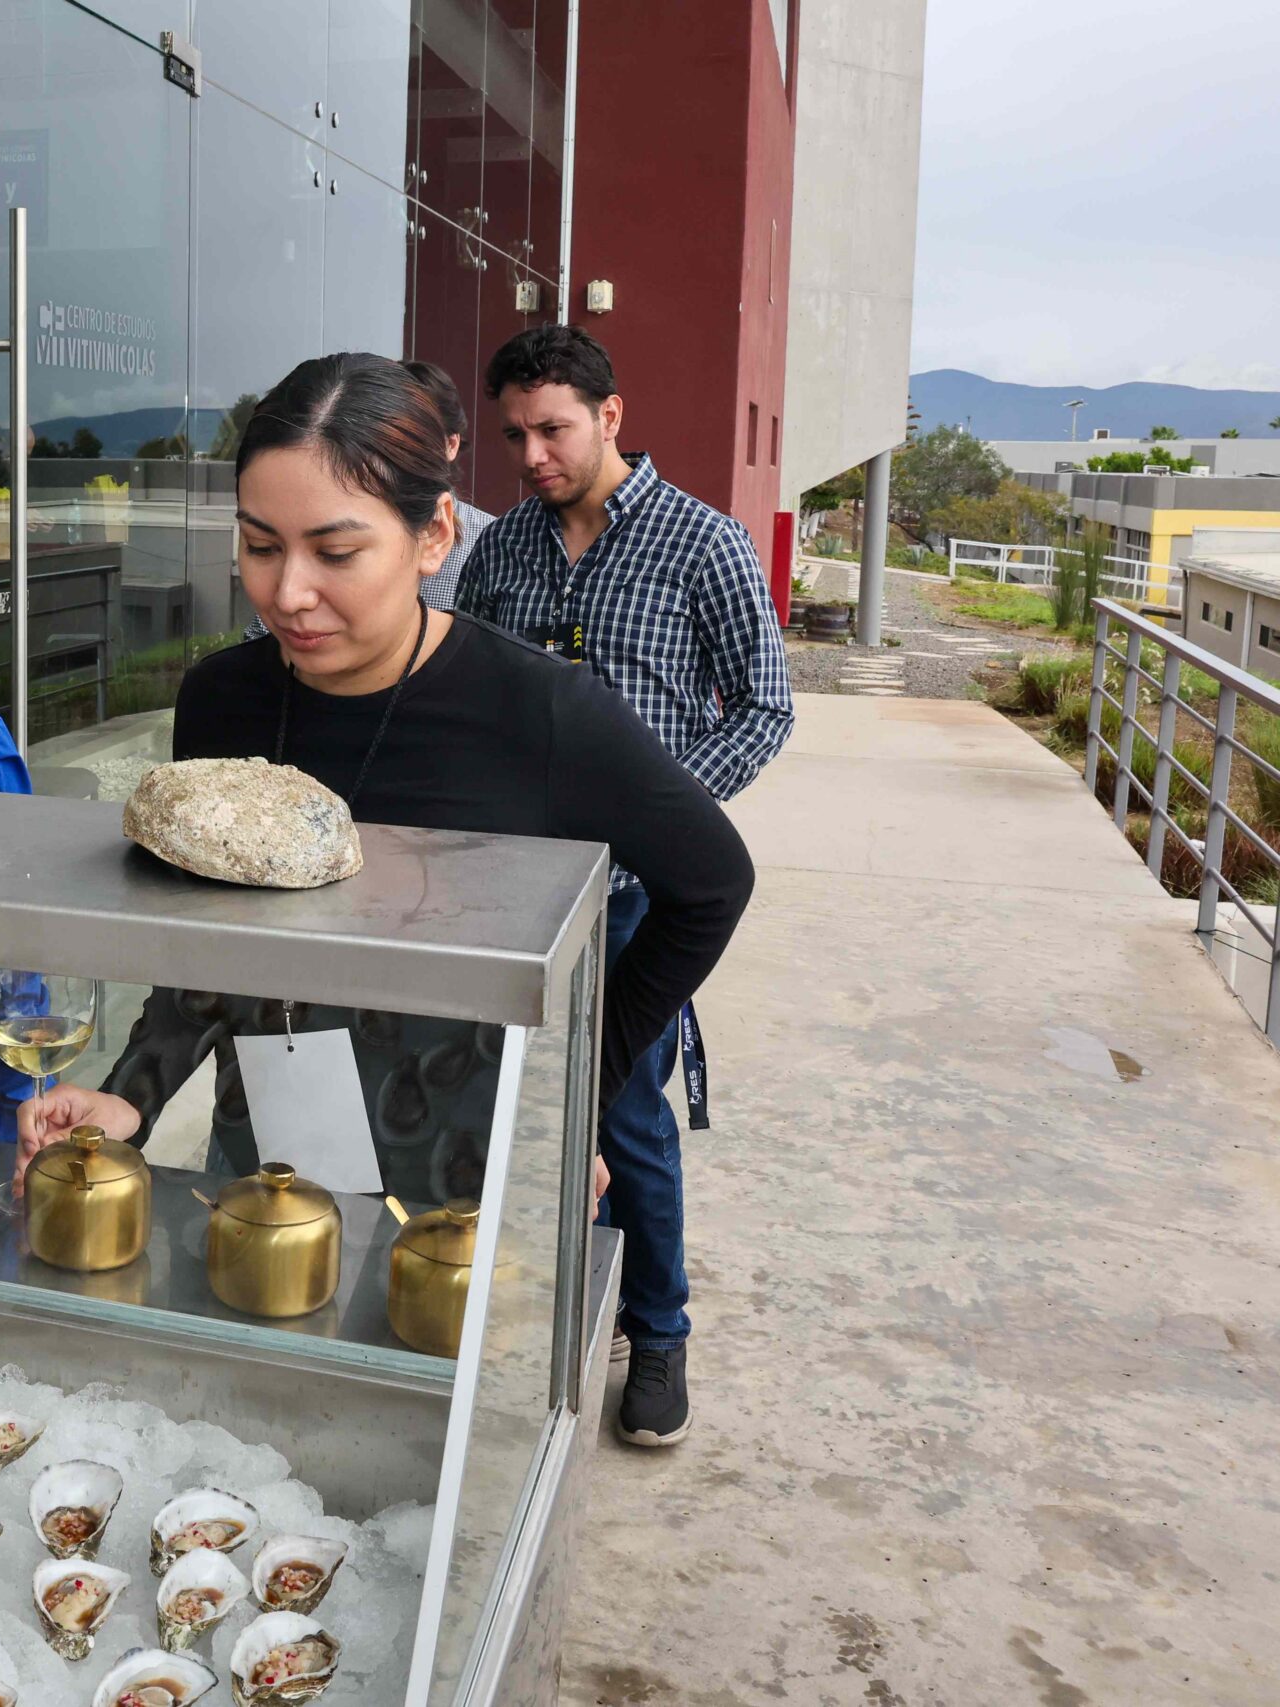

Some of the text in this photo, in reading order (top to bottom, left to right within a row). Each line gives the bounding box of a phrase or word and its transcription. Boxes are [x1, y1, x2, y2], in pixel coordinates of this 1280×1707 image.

[5, 182, 17, 204] y
[67, 304, 156, 341] CENTRO DE ESTUDIOS
[67, 337, 156, 377] VITIVINÍCOLAS
